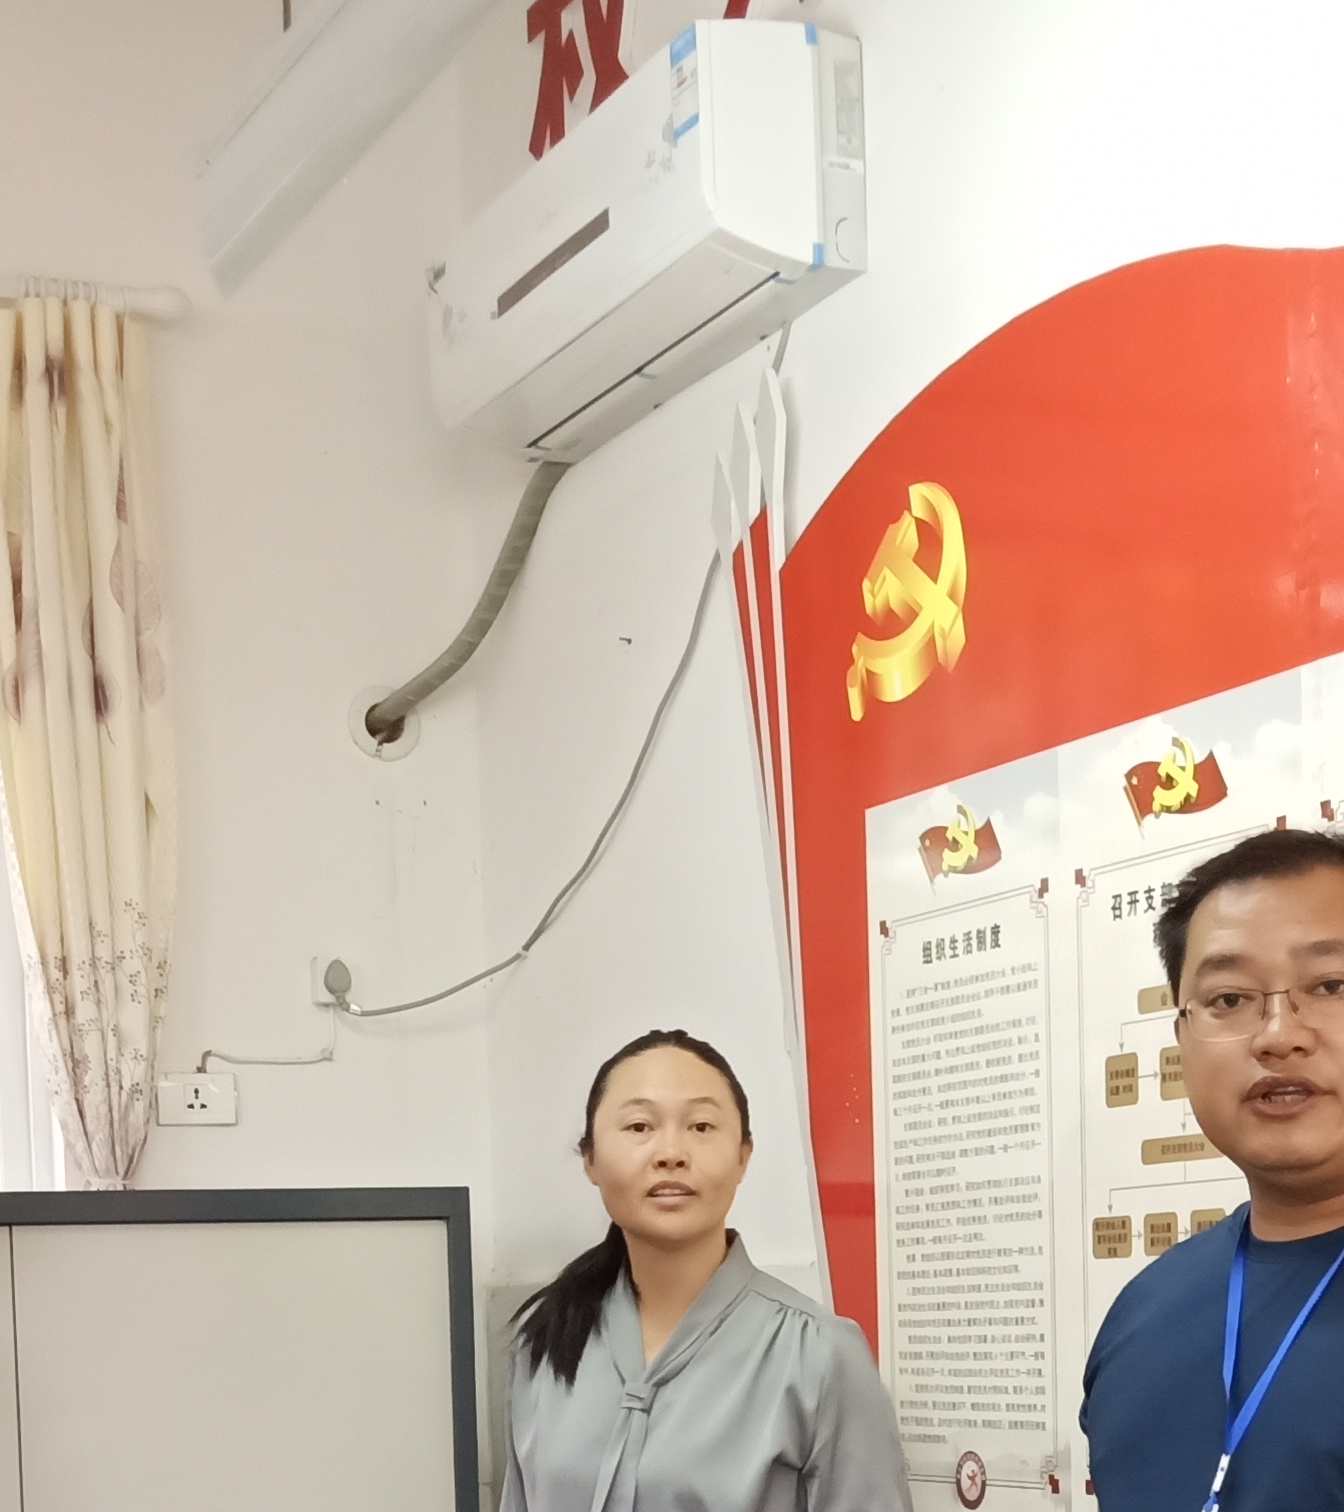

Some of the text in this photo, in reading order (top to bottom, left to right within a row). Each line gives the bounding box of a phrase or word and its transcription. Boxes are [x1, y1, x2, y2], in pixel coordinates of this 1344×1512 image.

[922, 923, 1001, 964] 组织生活制度
